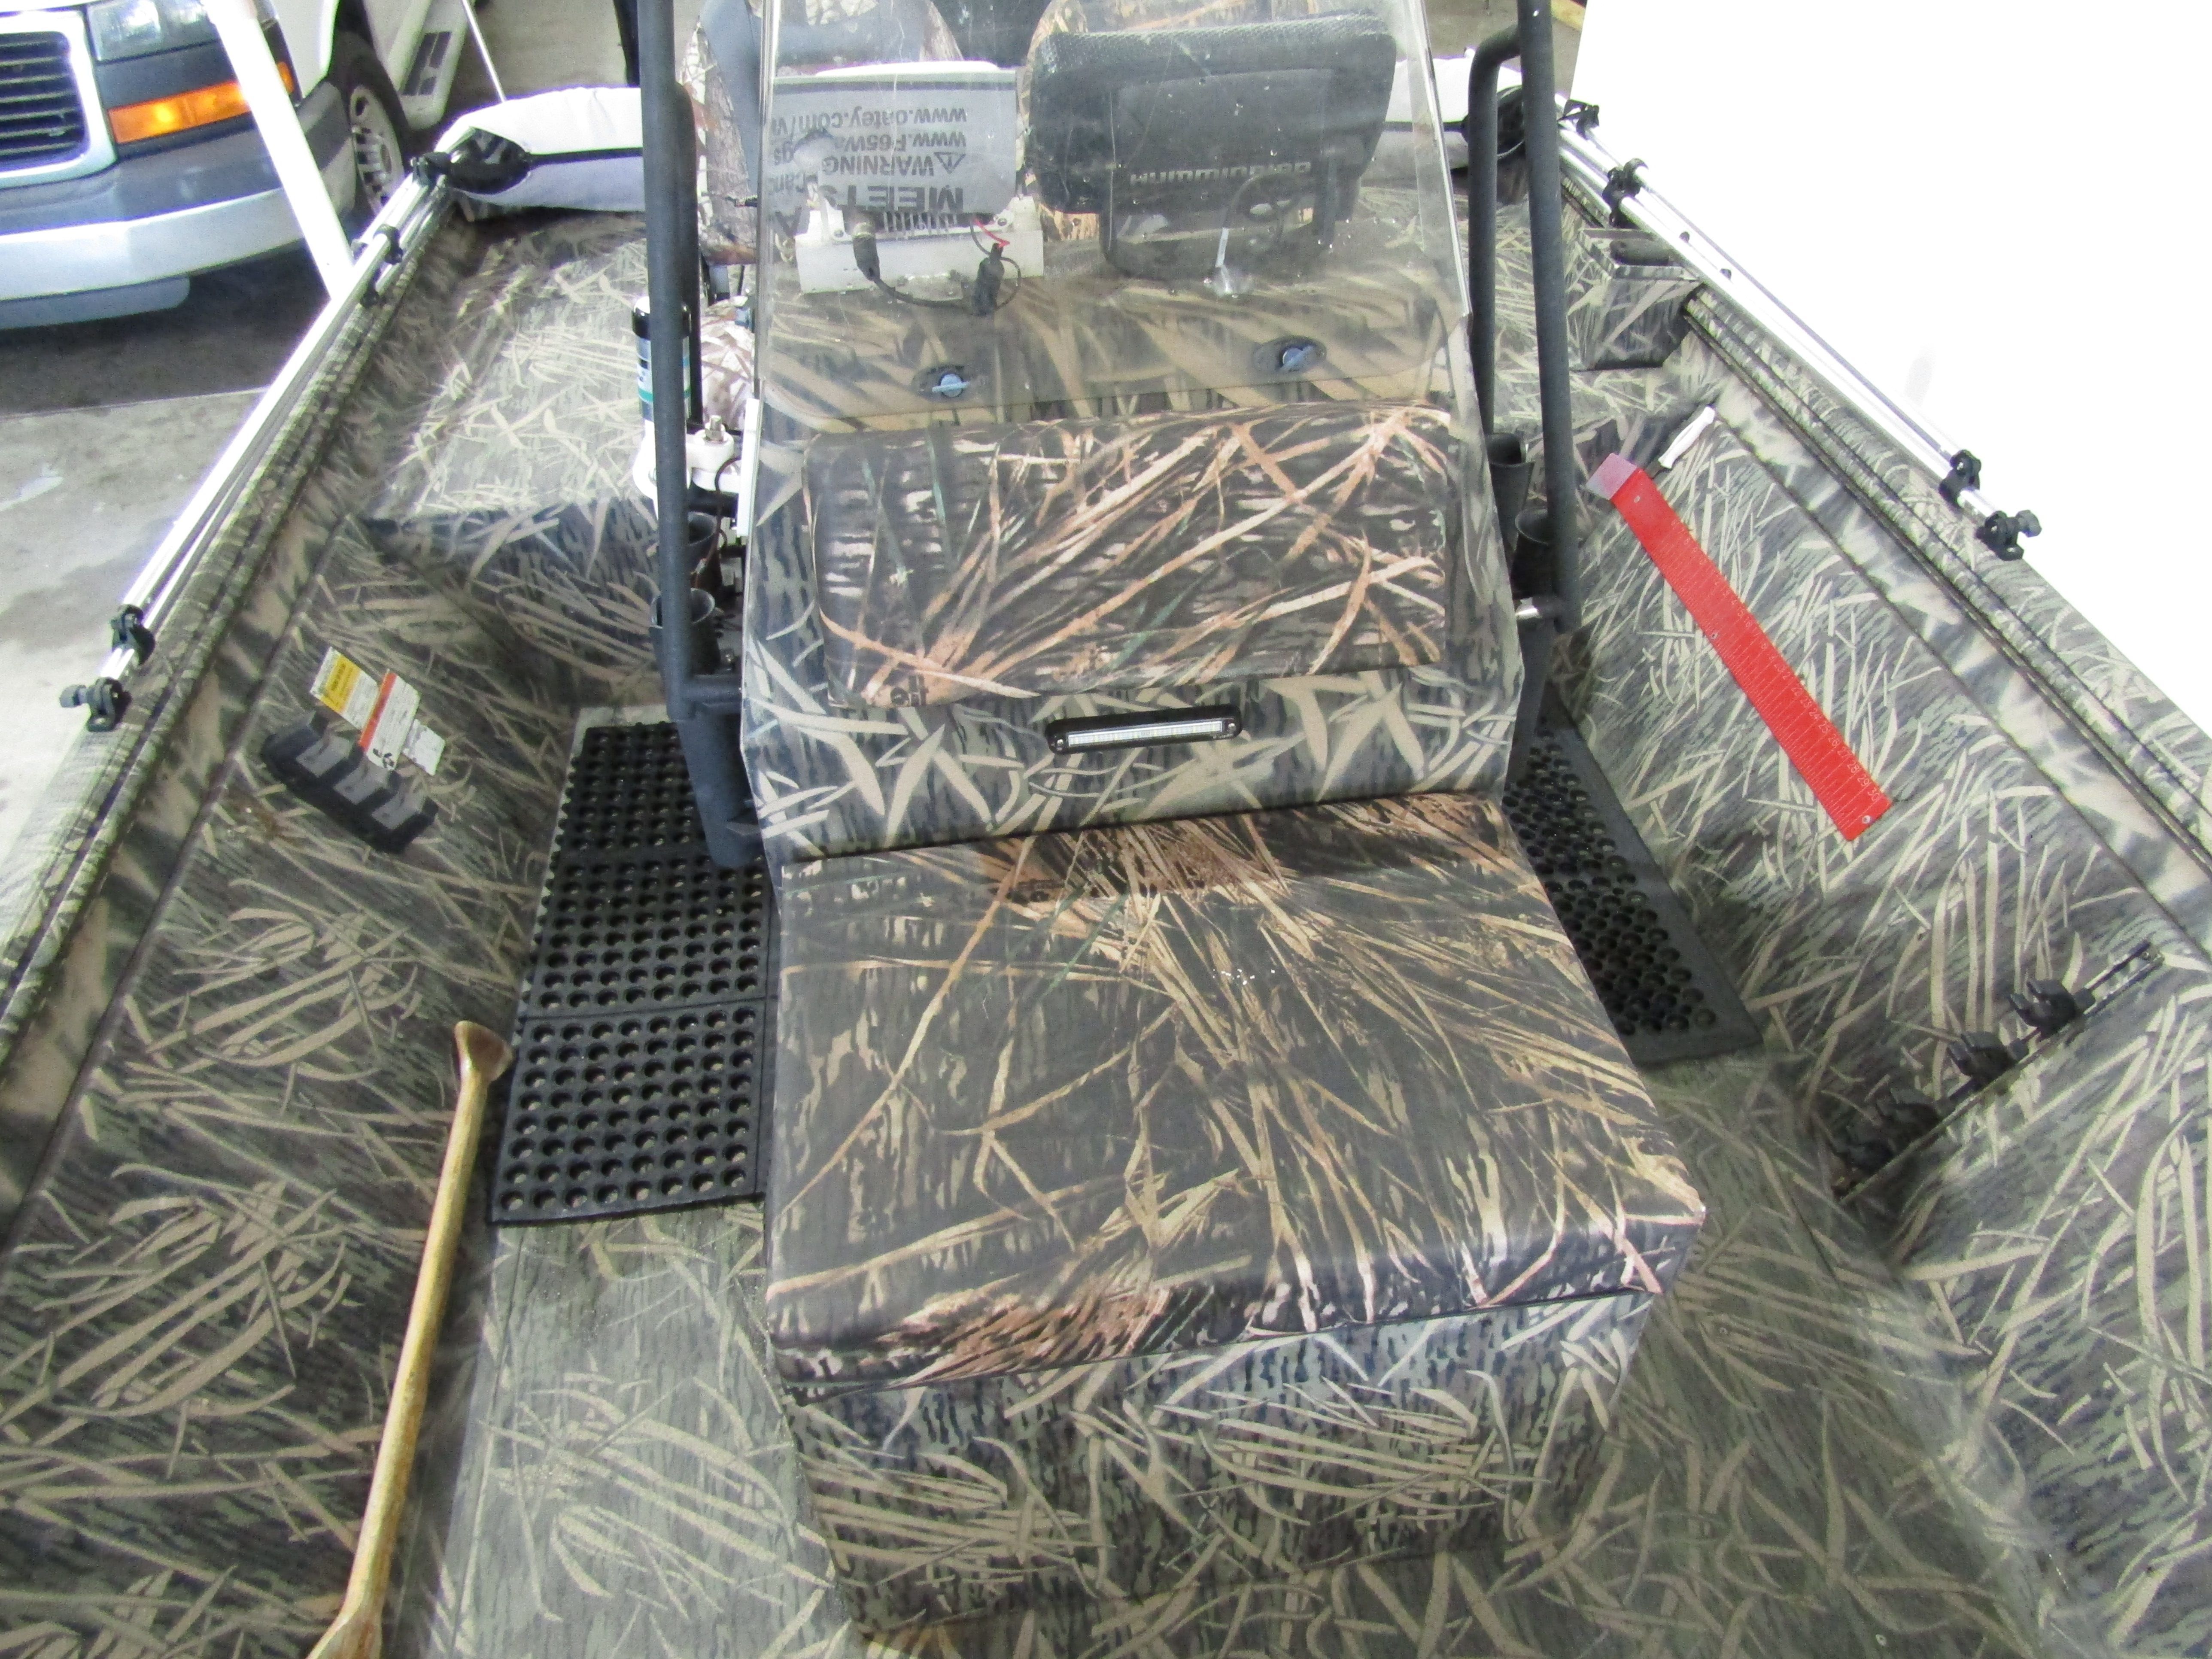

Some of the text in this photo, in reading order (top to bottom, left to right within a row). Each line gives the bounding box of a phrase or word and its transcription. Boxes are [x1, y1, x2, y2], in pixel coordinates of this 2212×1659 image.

[822, 155, 934, 176] WARNING
[1847, 761, 1860, 773] 28
[1857, 775, 1869, 787] 29
[1868, 788, 1880, 802] 30
